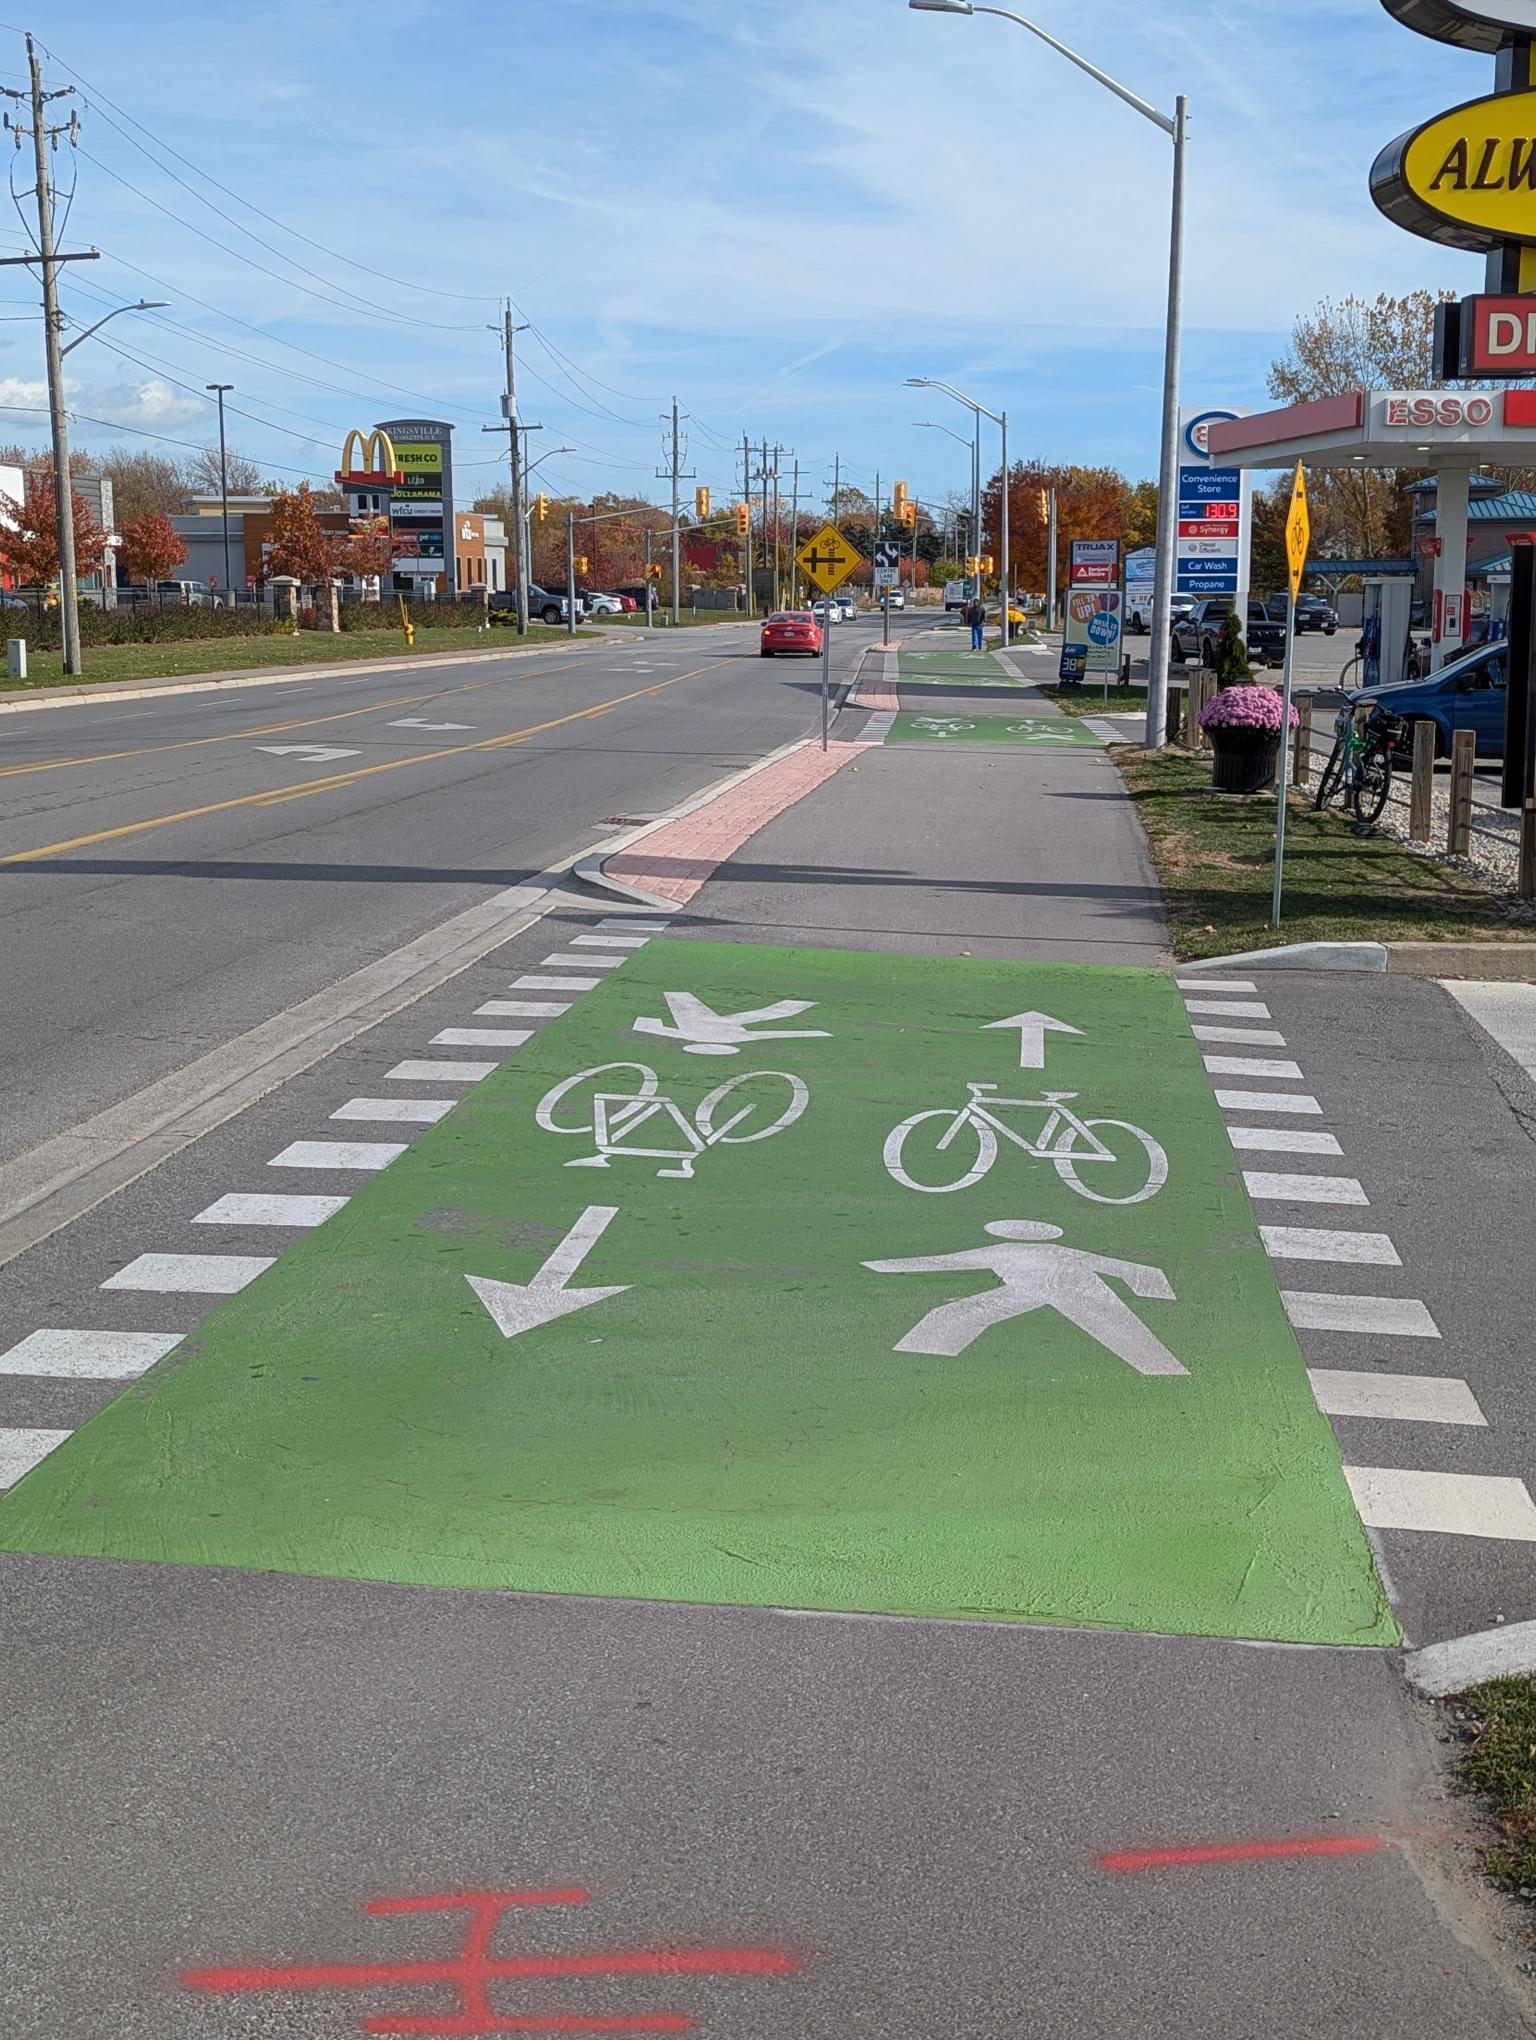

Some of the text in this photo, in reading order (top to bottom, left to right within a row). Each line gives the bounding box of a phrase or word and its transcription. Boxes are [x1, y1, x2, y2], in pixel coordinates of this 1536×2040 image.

[1385, 398, 1493, 426] ESSO
[387, 427, 442, 435] KINGSVILLE
[424, 454, 438, 462] CO
[1181, 474, 1238, 483] Convenience
[1197, 485, 1222, 493] Store
[1206, 504, 1237, 518] 130.9
[1199, 525, 1229, 535] Synergy
[1076, 543, 1114, 551] TRUAX
[1188, 562, 1228, 570] Car Wash
[1189, 580, 1225, 590] Propane
